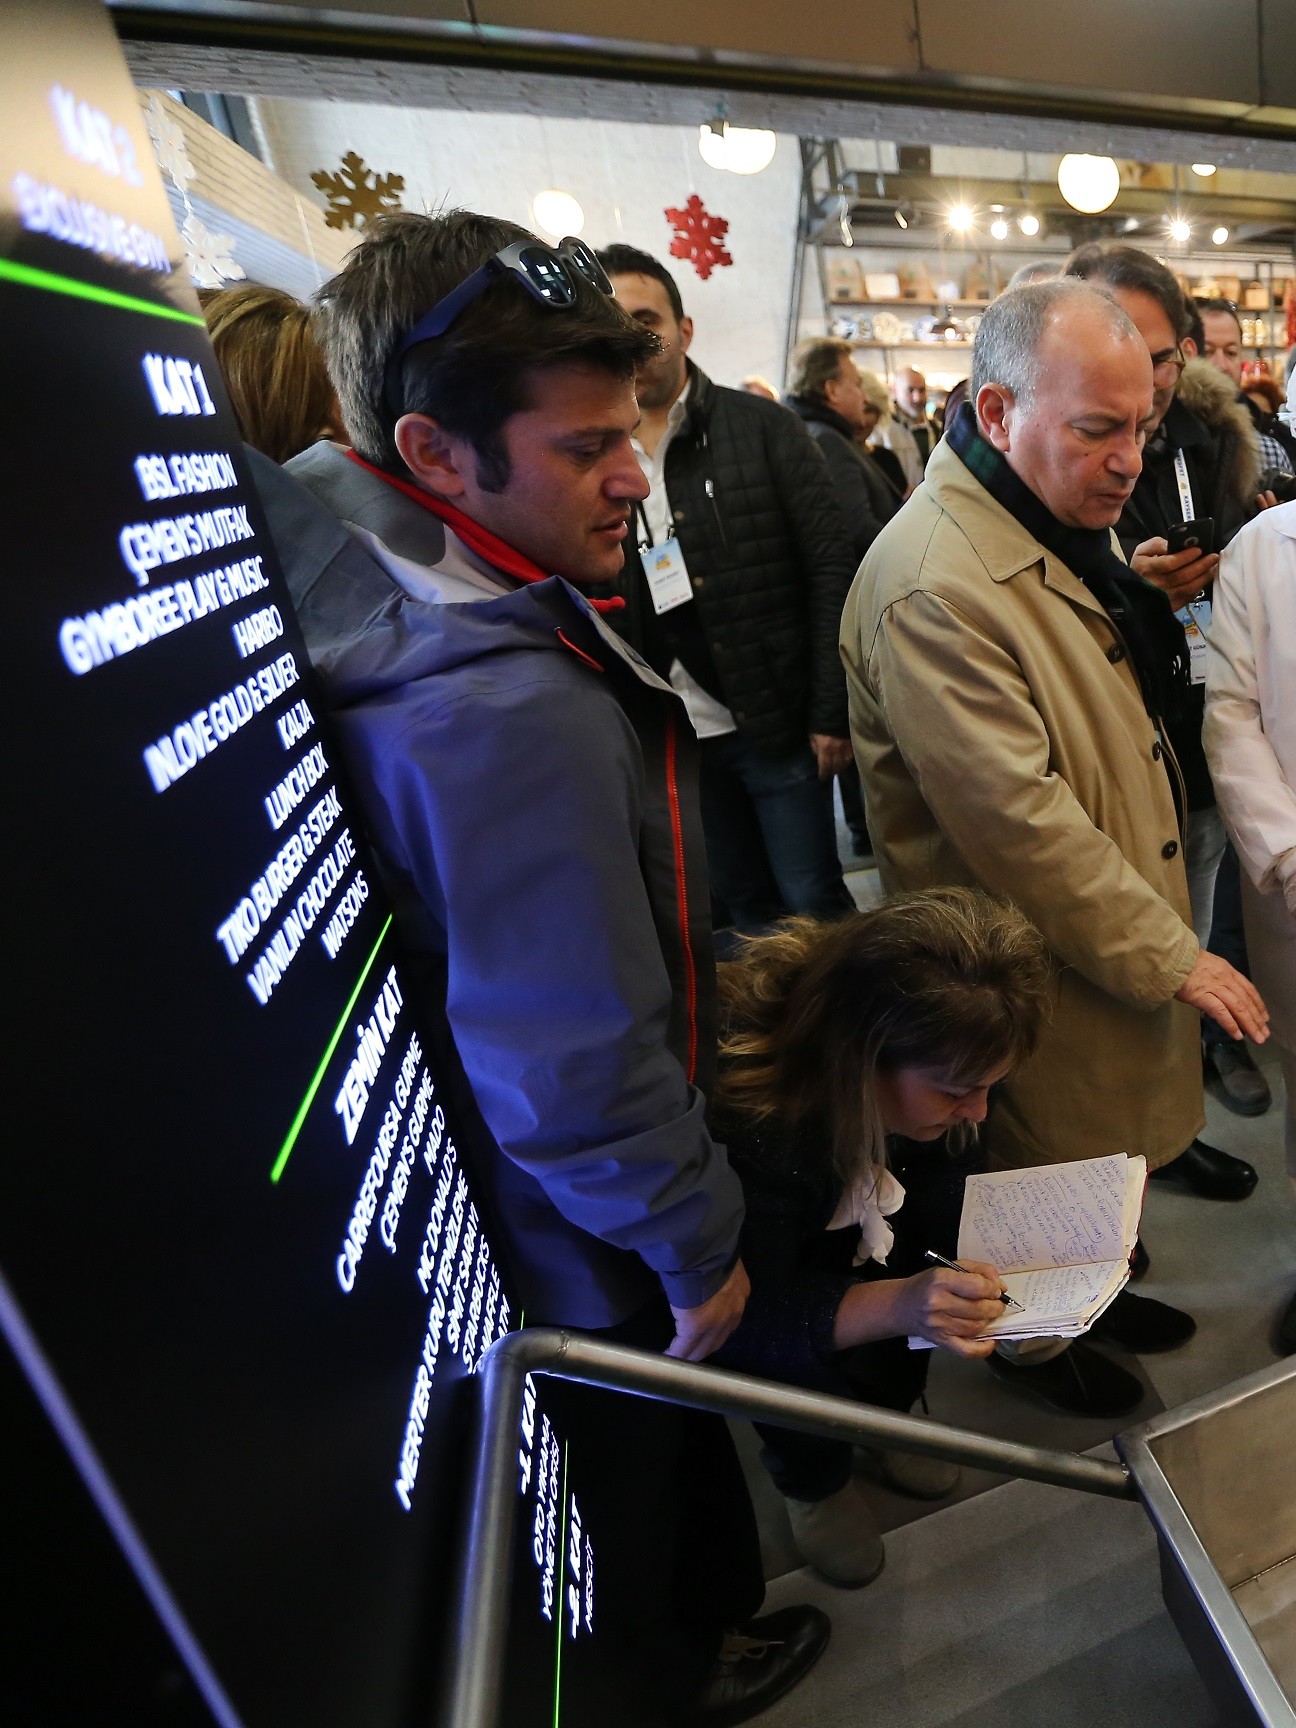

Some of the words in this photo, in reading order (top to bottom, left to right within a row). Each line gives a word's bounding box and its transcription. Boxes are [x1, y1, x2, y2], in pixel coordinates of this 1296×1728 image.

[141, 352, 202, 416] KAT
[134, 453, 181, 501] BSL
[170, 453, 238, 495] FASHION
[118, 513, 203, 587] ÇEMEN'S
[195, 505, 256, 552] MUTFAK
[57, 584, 185, 676] GYMBOREE
[174, 572, 221, 624] PLAY
[225, 555, 270, 600] MUSIC
[231, 604, 284, 659] HARIBO
[208, 684, 254, 742] GOLD
[256, 652, 301, 705] SILVER
[263, 763, 310, 831] LUNCH
[302, 742, 329, 790] BOX
[215, 897, 260, 965] TIKO
[250, 834, 308, 922] BURGER
[307, 785, 344, 846] STEAK
[296, 827, 356, 931] CHOCOLATE
[320, 869, 369, 960] WATSONS
[334, 1015, 386, 1146] ZEMİN
[373, 965, 403, 1043] KAT
[408, 1066, 434, 1147] GURME
[423, 1104, 445, 1175] MADO
[335, 1100, 402, 1293] CARREFOURSA
[394, 1031, 422, 1110] GURME
[416, 1240, 435, 1294] MC
[458, 1201, 479, 1289] SARAYI
[463, 1234, 489, 1374] STARBUCKS
[480, 1262, 500, 1353] WAFFLE
[394, 1363, 432, 1511] MERTER
[422, 1286, 446, 1375] KURU
[537, 1413, 551, 1505] YIKAMA
[533, 1503, 545, 1566] OTO
[569, 1492, 582, 1582] KAT
